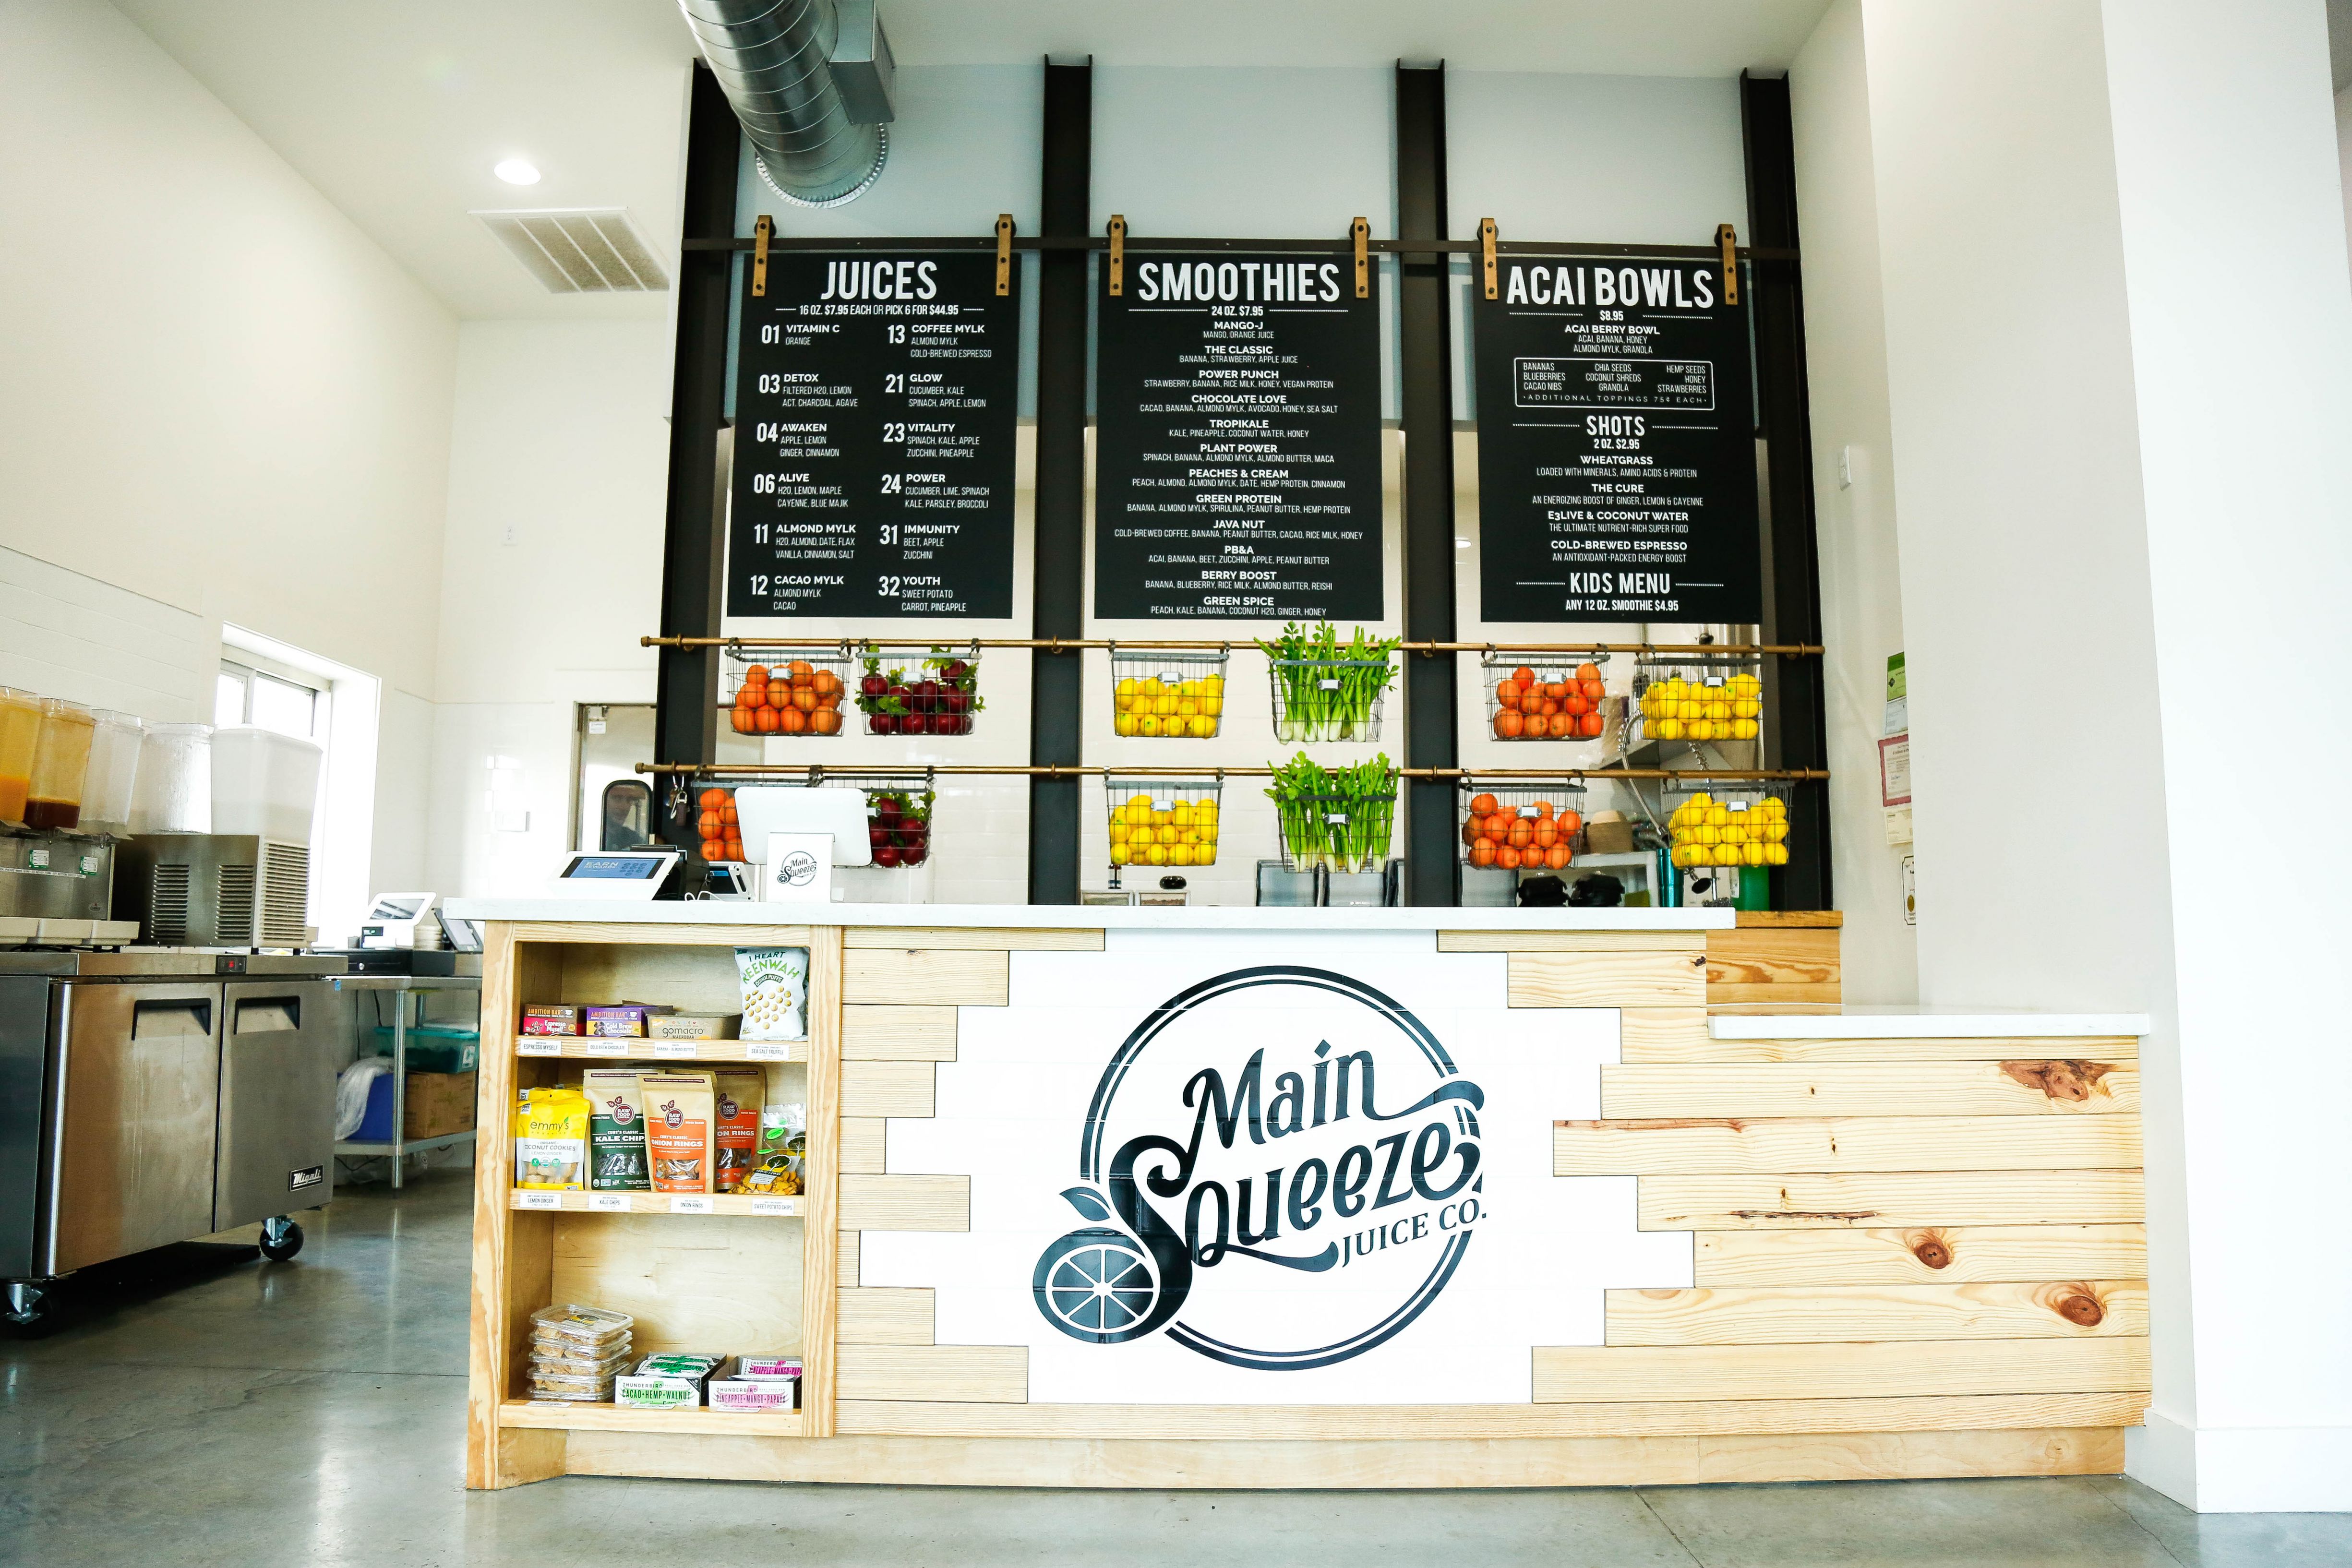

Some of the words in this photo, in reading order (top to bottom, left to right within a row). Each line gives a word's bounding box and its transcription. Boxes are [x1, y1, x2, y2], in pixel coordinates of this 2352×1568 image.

[821, 261, 937, 299] JUICES
[1139, 263, 1340, 302] SMOOTHIES
[1507, 266, 1585, 305] ACAI
[1595, 267, 1714, 308] BOWLS
[800, 305, 809, 315] 16
[810, 305, 823, 315] OZ.
[825, 304, 849, 315] $7.95
[850, 305, 871, 315] EACH
[873, 305, 884, 315] OR
[885, 305, 903, 315] PICK
[905, 305, 911, 315] 6
[912, 305, 927, 315] FOR
[929, 304, 959, 315] $44.95
[1212, 306, 1223, 316] 24
[1224, 306, 1237, 316] OZ.
[1239, 305, 1263, 316] $7.95
[1600, 310, 1623, 321] $8.95
[786, 324, 829, 333] VITAMIN
[832, 324, 840, 333] C
[912, 324, 952, 333] COFFEE
[1214, 322, 1263, 330] MANGO-J
[1565, 324, 1589, 333] ACAI
[1592, 325, 1626, 334] BERRY
[1628, 325, 1660, 335] BOWL
[762, 325, 780, 344] 01
[888, 324, 905, 344] 13
[786, 337, 811, 345] ORANGE
[1204, 346, 1226, 354] THE
[1228, 346, 1273, 354] CLASSIC
[784, 374, 819, 382] DETOX
[910, 374, 943, 382] GLOW
[1199, 370, 1238, 378] POWER
[1241, 370, 1279, 379] PUNCH
[759, 374, 780, 394] 03
[885, 374, 903, 393] 21
[1191, 395, 1257, 403] CHOCOLATE
[1259, 395, 1286, 404] LOVE
[781, 423, 827, 431] AWAKEN
[908, 423, 955, 432] VITALITY
[1210, 419, 1269, 428] TROPIKALE
[1586, 415, 1645, 436] SHOTS
[757, 423, 778, 442] 04
[883, 423, 905, 442] 23
[1200, 444, 1236, 452] PLANT
[1238, 444, 1277, 453] POWER
[1594, 438, 1599, 449] 2
[1601, 438, 1614, 449] OZ.
[1616, 438, 1640, 450] $2.95
[1580, 455, 1653, 465] WHEATGRASS
[779, 473, 809, 482] ALIVE
[906, 474, 946, 482] POWER
[1189, 469, 1238, 478] PEACHES
[1240, 469, 1248, 478] &
[1251, 469, 1288, 478] CREAM
[754, 474, 775, 493] 06
[881, 474, 901, 493] 24
[1591, 484, 1613, 492] THE
[1615, 484, 1644, 493] CURE
[1196, 494, 1232, 503] GREEN
[1236, 494, 1282, 503] PROTEIN
[1548, 511, 1584, 521] E3LIVE
[1586, 511, 1594, 520] &
[1596, 511, 1650, 520] COCONUT
[1652, 512, 1689, 521] WATER
[776, 524, 823, 533] ALMOND
[826, 525, 856, 533] MYLK
[904, 525, 960, 534] IMMUNITY
[1213, 520, 1239, 528] JAVA
[1242, 520, 1265, 529] NUT
[754, 524, 768, 543] 11
[879, 525, 898, 545] 31
[1224, 545, 1254, 554] PB&A
[1551, 540, 1631, 550] COLD-BREWED
[1634, 541, 1687, 550] ESPRESSO
[775, 575, 811, 584] CACAO
[814, 576, 844, 585] MYLK
[903, 576, 940, 585] YOUTH
[1202, 571, 1237, 580] BERRY
[1239, 571, 1277, 580] BOOST
[750, 575, 768, 595] 12
[878, 576, 900, 596] 32
[1571, 572, 1612, 593] KIDS
[1619, 573, 1670, 594] MENU
[1203, 596, 1240, 606] GREEN
[1243, 597, 1274, 606] SPICE
[1566, 599, 1582, 610] ANY
[1585, 599, 1595, 610] 12
[1597, 599, 1610, 610] OZ.
[1612, 599, 1653, 611] SMOOTHIE
[1655, 600, 1679, 611] $4.95
[791, 858, 815, 867] Main
[782, 865, 816, 881] Squeeze
[755, 951, 786, 960] HEART
[768, 974, 782, 983] PUFFS
[662, 1028, 704, 1038] gomacro
[1183, 1039, 1462, 1158] Main
[530, 1119, 569, 1132] emmy's
[1091, 1124, 1480, 1305] Squeeze
[1342, 1211, 1429, 1269] JUICE
[1438, 1197, 1488, 1232] CO.
